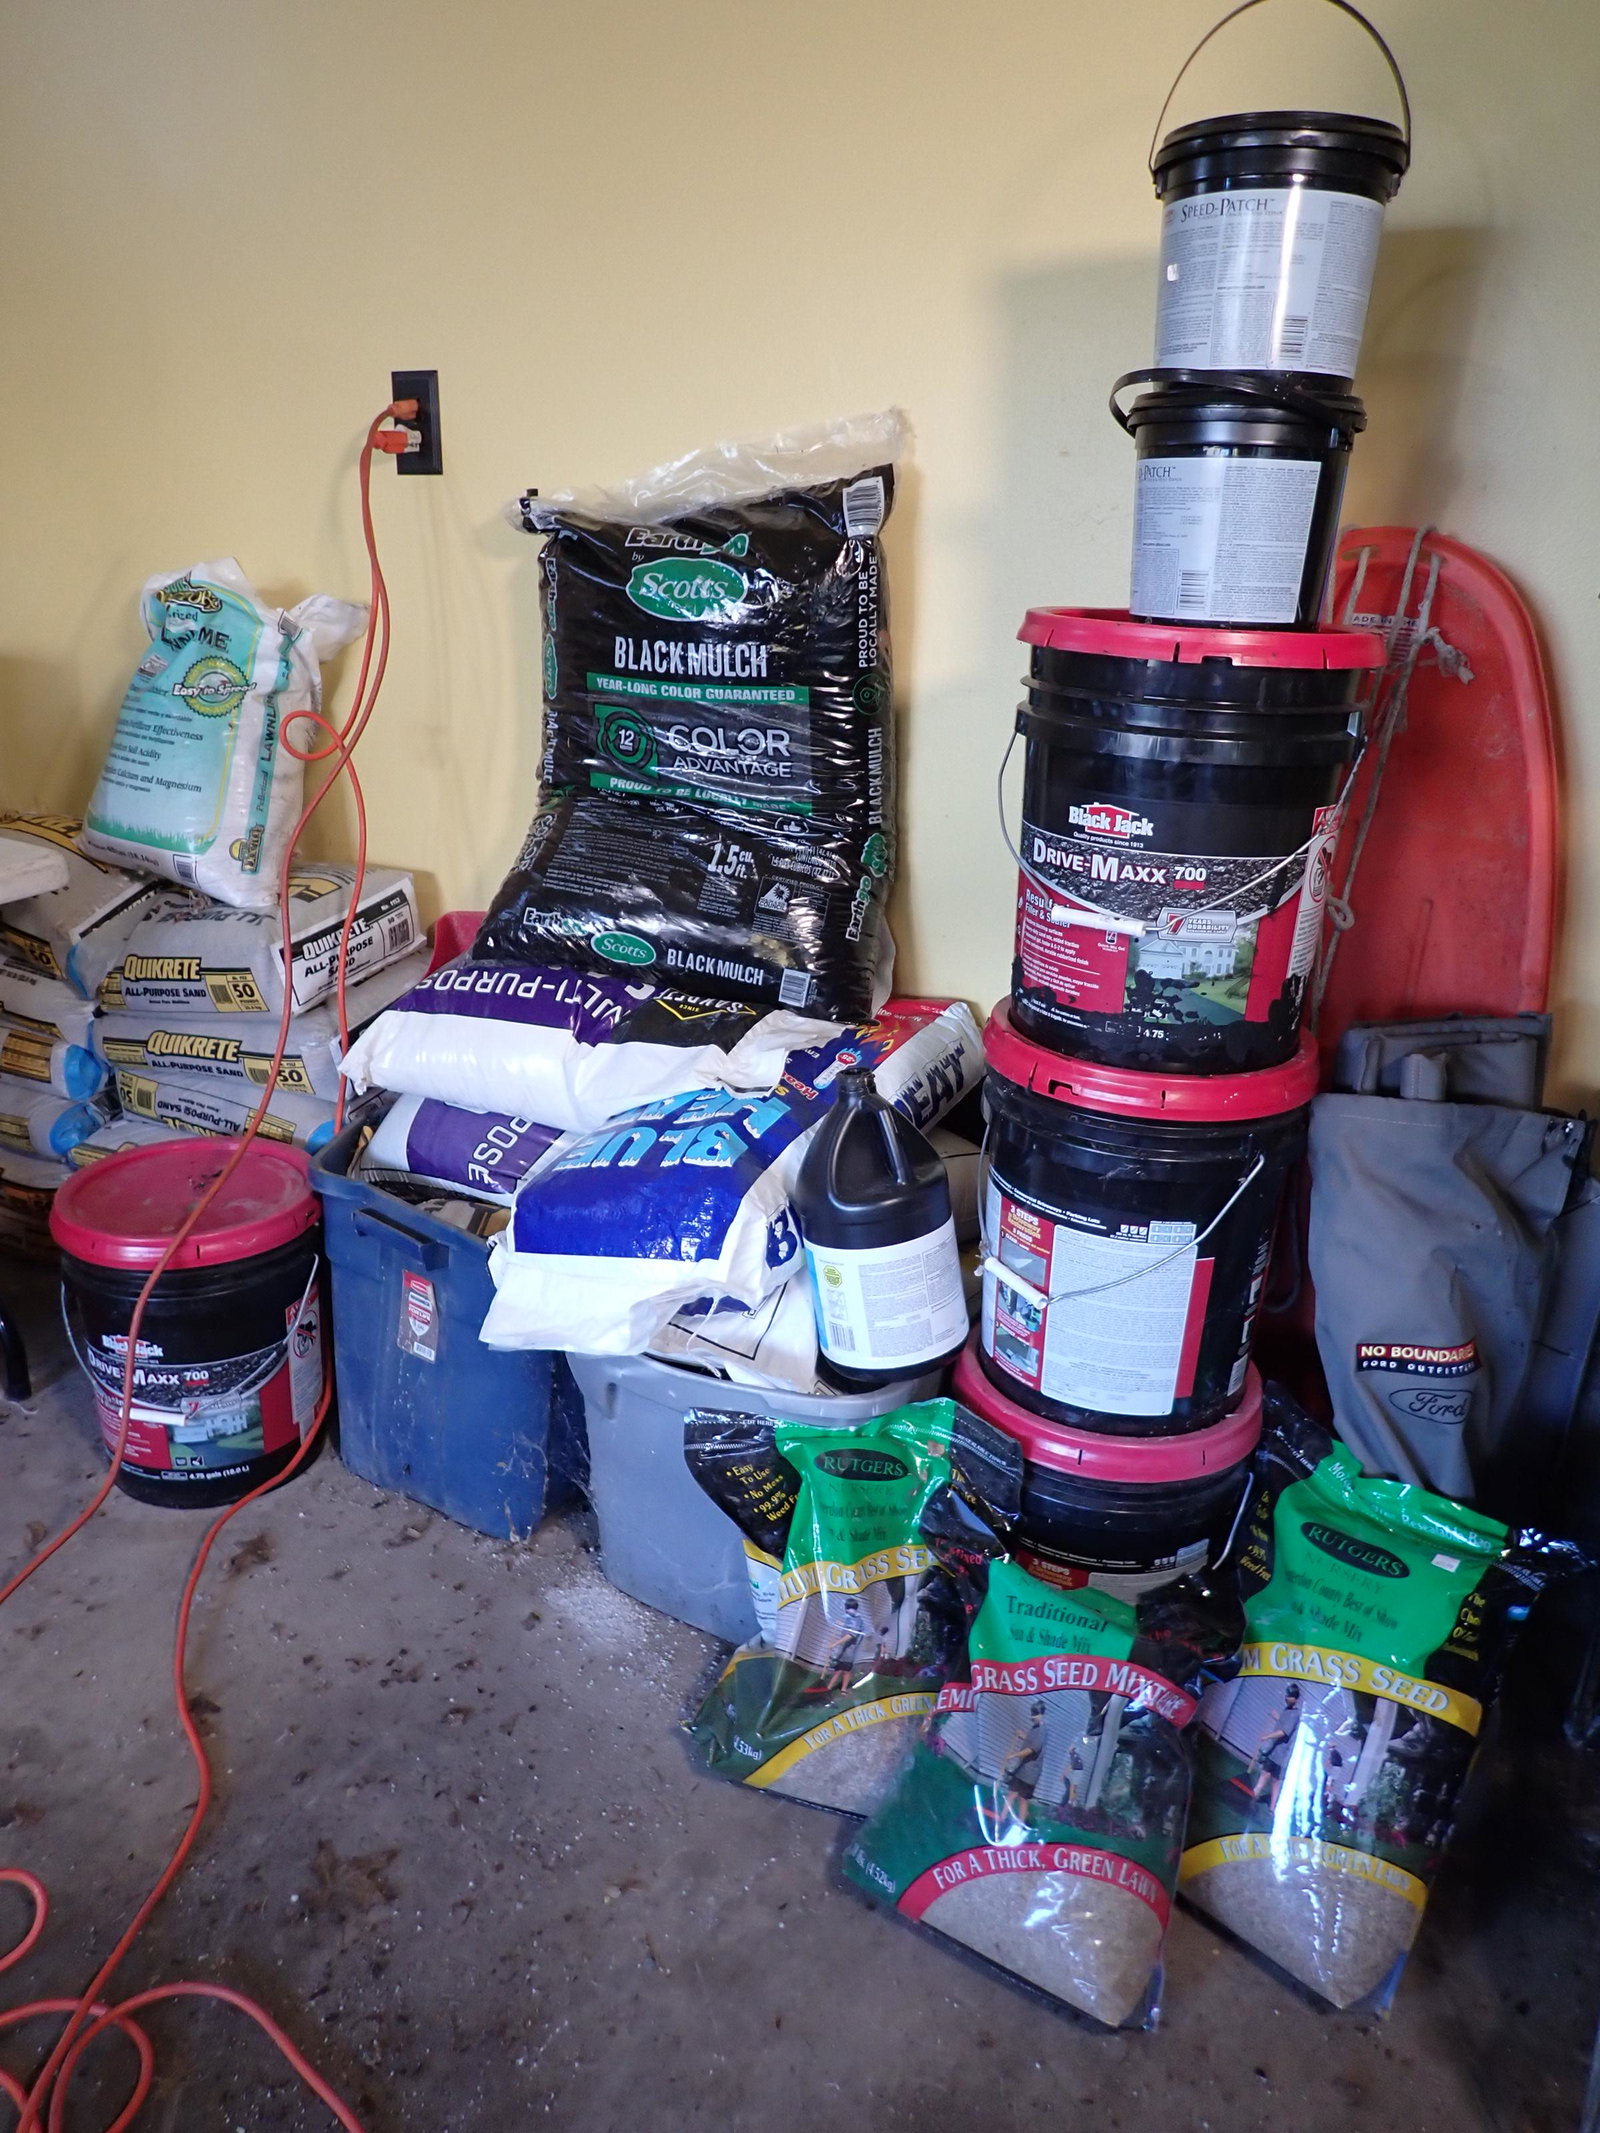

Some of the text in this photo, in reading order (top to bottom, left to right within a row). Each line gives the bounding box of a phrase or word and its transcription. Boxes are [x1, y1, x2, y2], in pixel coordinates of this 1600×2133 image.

[1181, 198, 1269, 222] SPEED-PATCH
[632, 551, 645, 562] by
[639, 572, 728, 600] Scotts
[858, 570, 869, 668] PROUD TO BE
[869, 556, 878, 667] LOCALLY MADE
[1353, 615, 1376, 625] ADE
[614, 636, 768, 678] BLACK MULCH
[172, 682, 200, 697] Easy
[202, 684, 215, 695] to
[597, 677, 795, 701] YEAR-LONG COLOR GUARANTEED
[152, 725, 204, 742] Effectiveness
[618, 728, 635, 746] 12
[667, 725, 791, 757] COLOR
[139, 745, 162, 761] Acidity
[867, 727, 882, 778] MULCH
[543, 746, 554, 783] MULC
[673, 756, 792, 777] ADVANTAGE
[140, 773, 154, 785] and
[155, 776, 202, 793] Magnesium
[609, 777, 652, 791] PROUD
[675, 787, 692, 797] BE
[868, 778, 883, 826] BLACK
[1068, 806, 1155, 837] Black Jack
[1073, 831, 1090, 842] Quality
[1090, 835, 1114, 845] products
[1114, 838, 1130, 847] since
[706, 842, 755, 875] 1.5 cu.
[1033, 837, 1207, 885] DRIVE-MAXX 700
[734, 864, 748, 880] ft.
[1039, 911, 1045, 919] &
[1167, 914, 1186, 936] 7
[600, 937, 648, 960] Scotts
[123, 954, 202, 982] QUIKRETE
[667, 949, 765, 986] BLACK MULCH
[125, 986, 207, 999] ALL-PURPOSE SAND
[232, 983, 256, 999] 50
[678, 1003, 701, 1013] SINCE
[146, 1030, 243, 1063] QUIKRETE
[151, 1060, 244, 1078] ALL-PURPOSE SAND
[277, 1067, 303, 1083] 50
[157, 1100, 181, 1112] SAND
[551, 1122, 750, 1172] BLUE
[1010, 1204, 1039, 1227] 3 STEPS
[1360, 1345, 1386, 1358] NO
[183, 1370, 210, 1381] 700
[1362, 1360, 1397, 1369] FORD
[1409, 1391, 1468, 1418] Ford
[732, 1463, 754, 1477] Easy
[740, 1467, 771, 1486] To Use
[823, 1456, 904, 1477] RUTGERS
[749, 1475, 784, 1500] No Mess
[759, 1490, 786, 1513] 99.9%
[766, 1501, 791, 1522] Weed
[1307, 1526, 1404, 1576] RUTGERS
[823, 1552, 891, 1589] GRASS
[1041, 1561, 1070, 1576] STEPS
[1005, 1595, 1109, 1633] Traditional
[1026, 1626, 1035, 1643] &
[1038, 1628, 1068, 1649] Shade
[970, 1659, 1186, 1720] GRASS SEED MIXTURE
[1269, 1644, 1450, 1714] GRASS SEED
[802, 1729, 832, 1750] FOR
[832, 1719, 846, 1735] A
[932, 1859, 964, 1890] FOR
[967, 1853, 982, 1873] A
[1052, 1847, 1114, 1877] GREEN
[1117, 1863, 1159, 1904] LAWN
